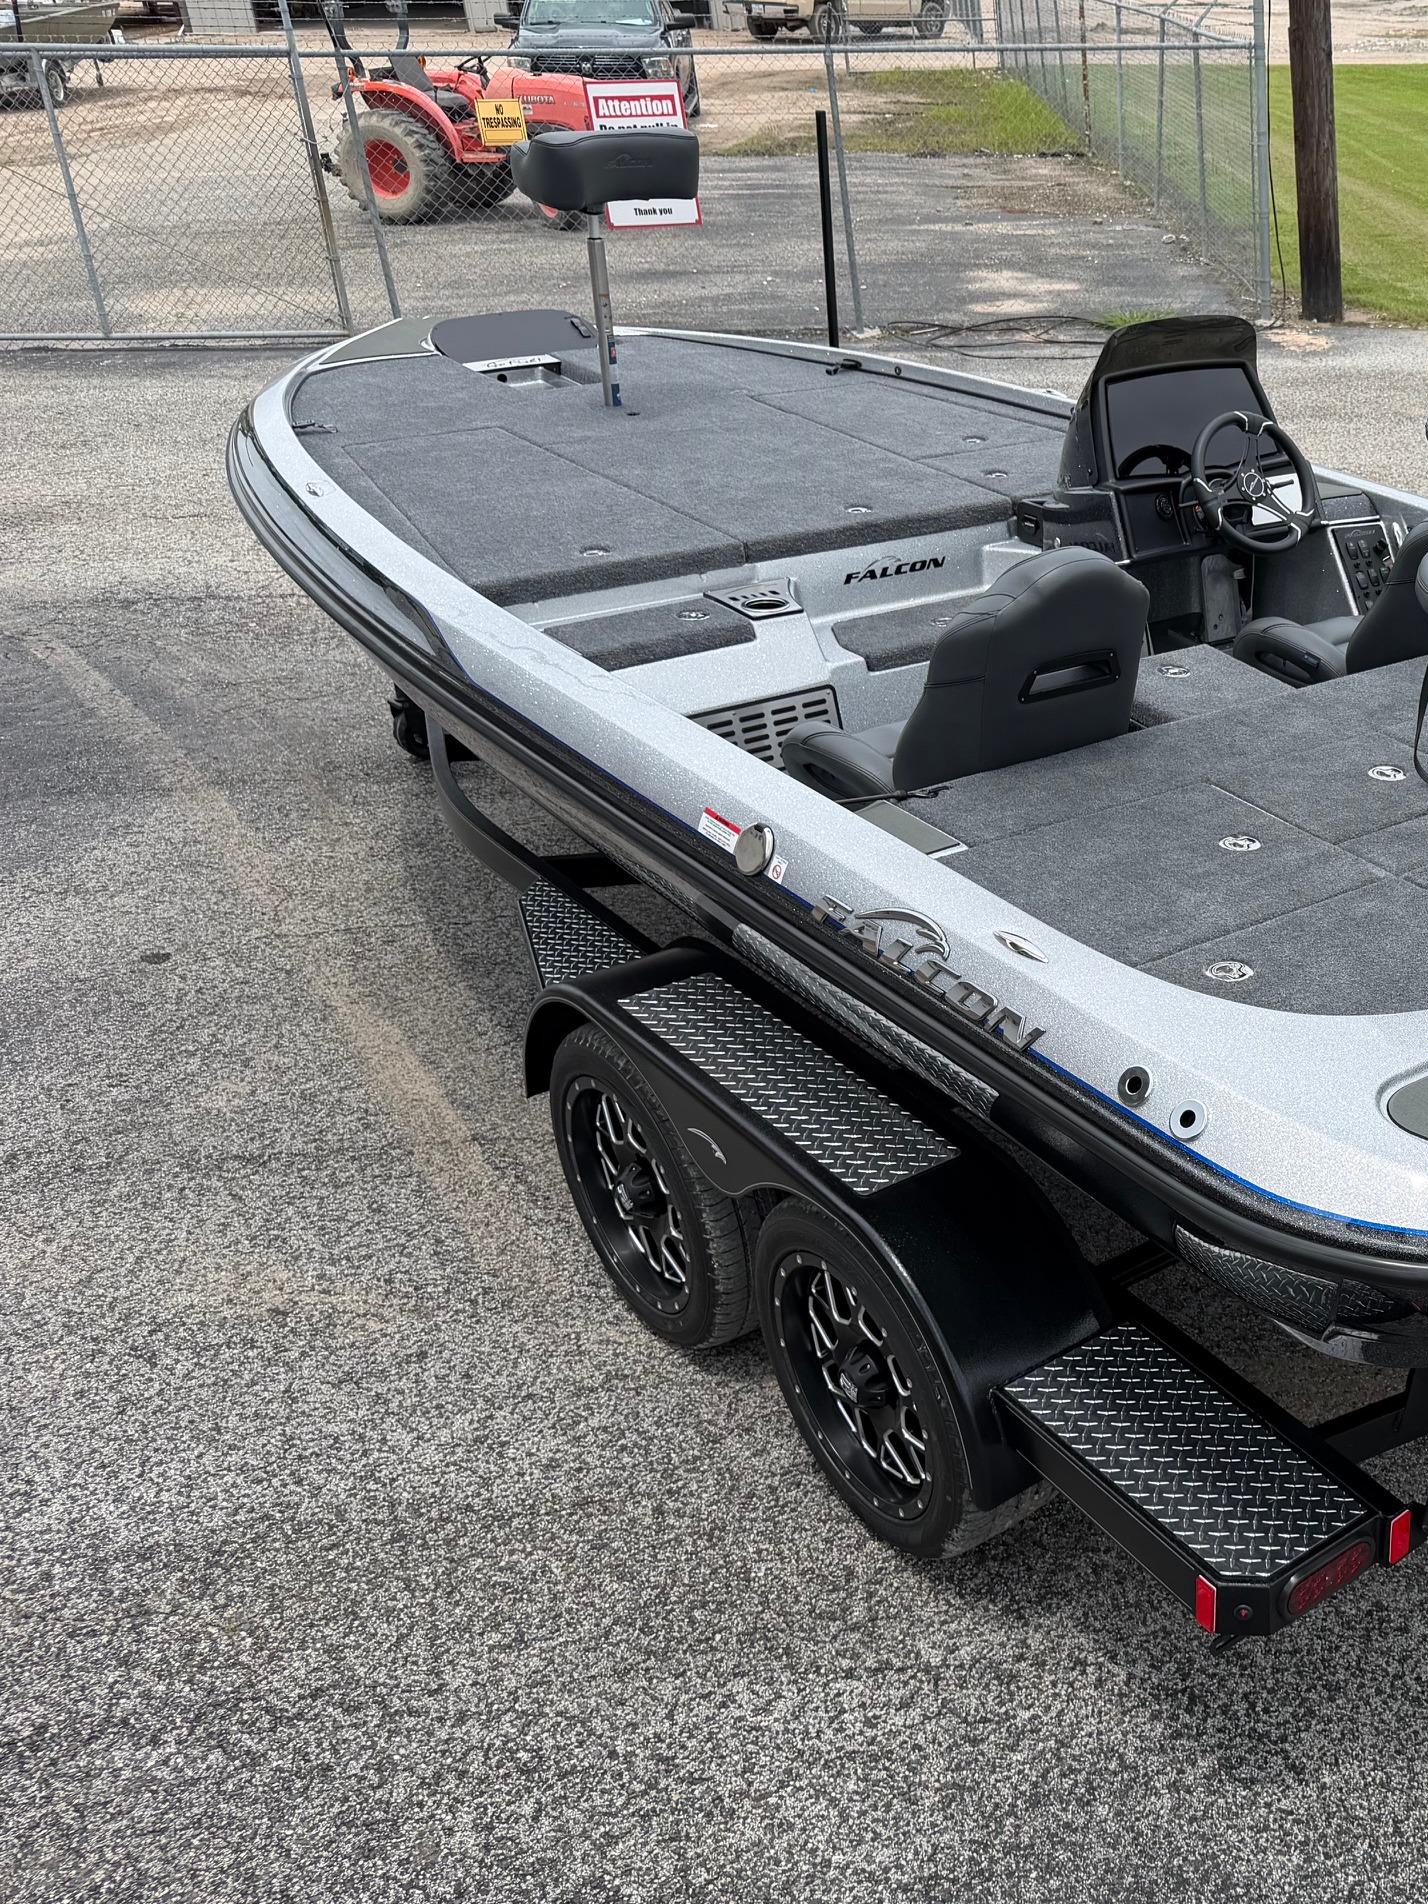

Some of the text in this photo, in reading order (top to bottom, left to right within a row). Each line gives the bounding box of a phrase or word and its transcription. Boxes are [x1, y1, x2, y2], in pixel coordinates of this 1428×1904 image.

[494, 103, 504, 115] NO
[597, 97, 674, 117] Attention
[482, 116, 522, 129] TRESPASSING
[633, 207, 673, 217] Thank you
[843, 555, 946, 585] FALCON
[811, 894, 1047, 1051] FALCON
